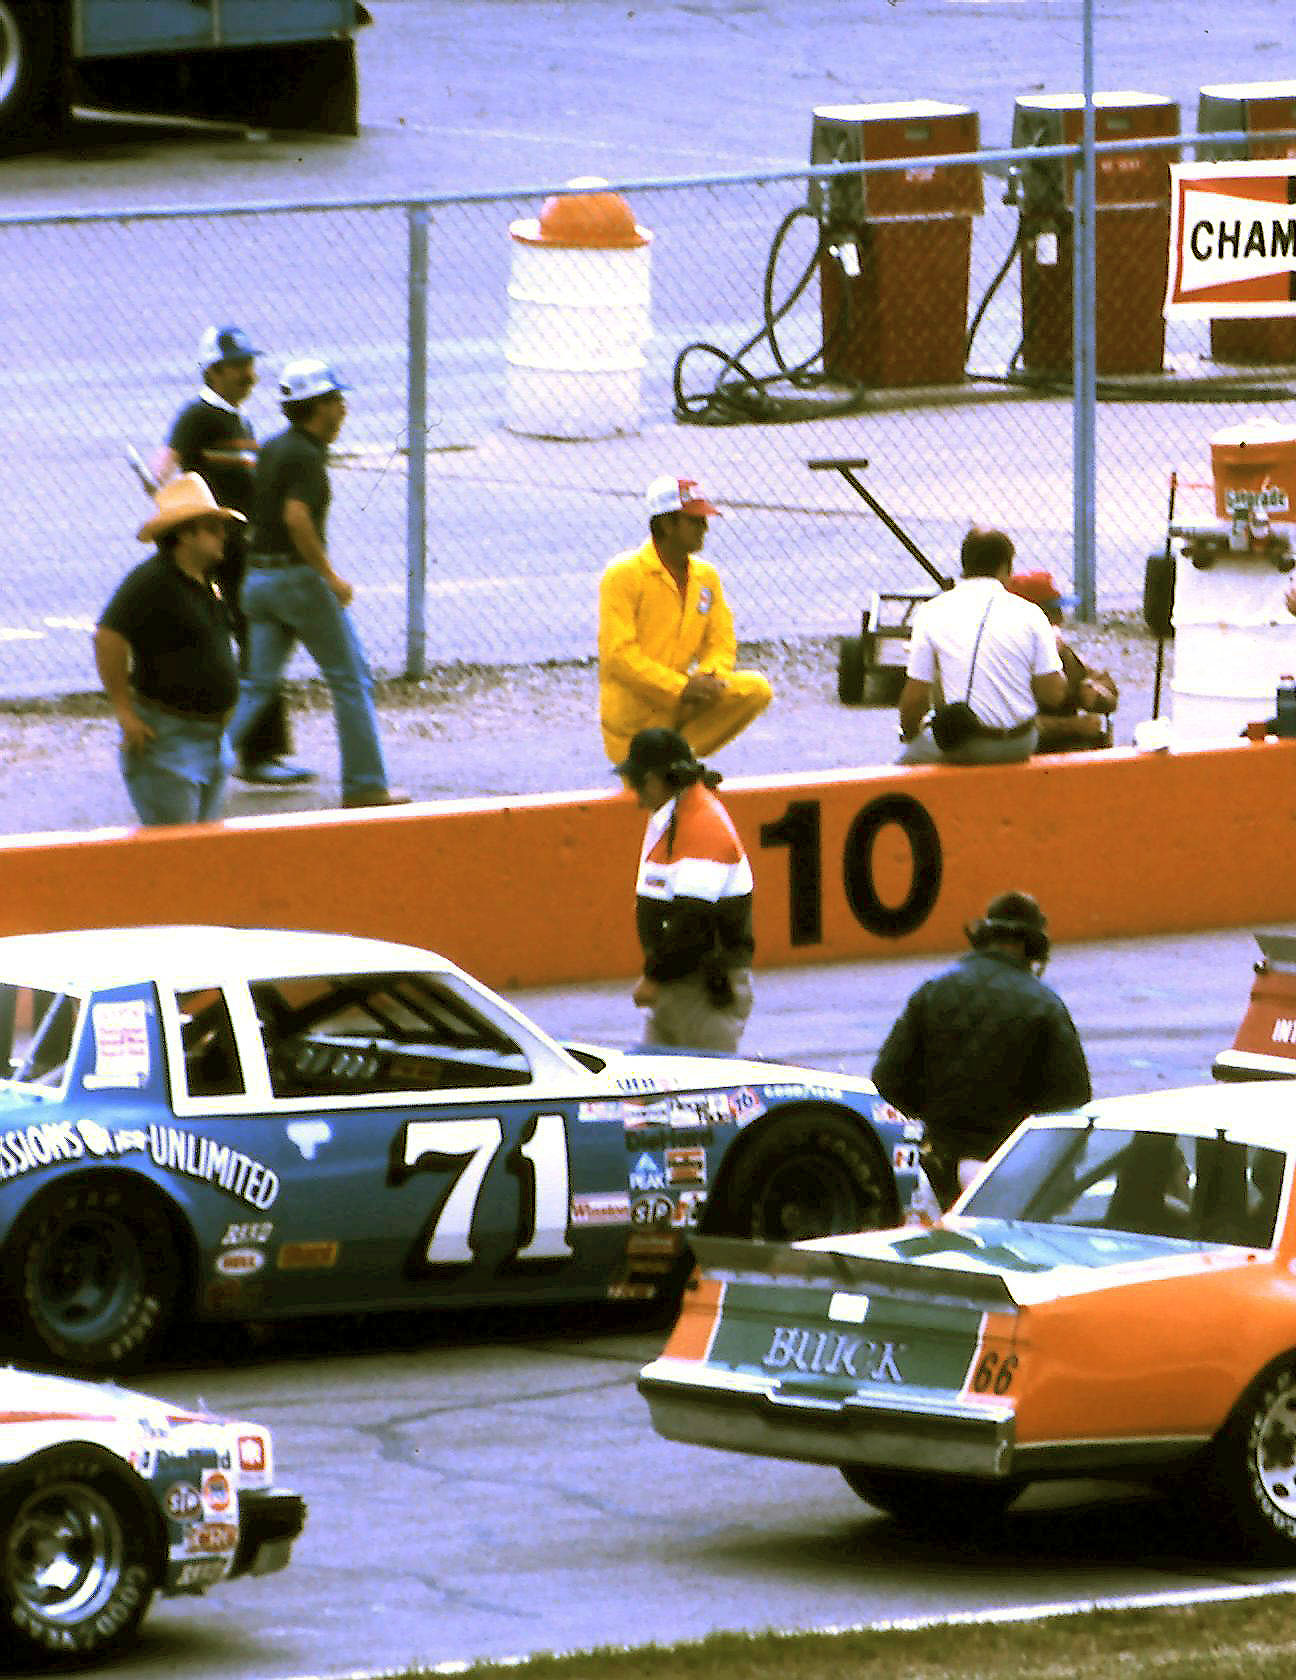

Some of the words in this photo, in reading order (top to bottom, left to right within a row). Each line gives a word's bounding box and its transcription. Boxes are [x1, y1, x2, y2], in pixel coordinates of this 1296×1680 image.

[759, 792, 943, 946] 10
[150, 1123, 280, 1210] UNLIMITED
[401, 1114, 574, 1265] 71
[763, 1326, 904, 1385] BUICK
[973, 1351, 1019, 1395] 66
